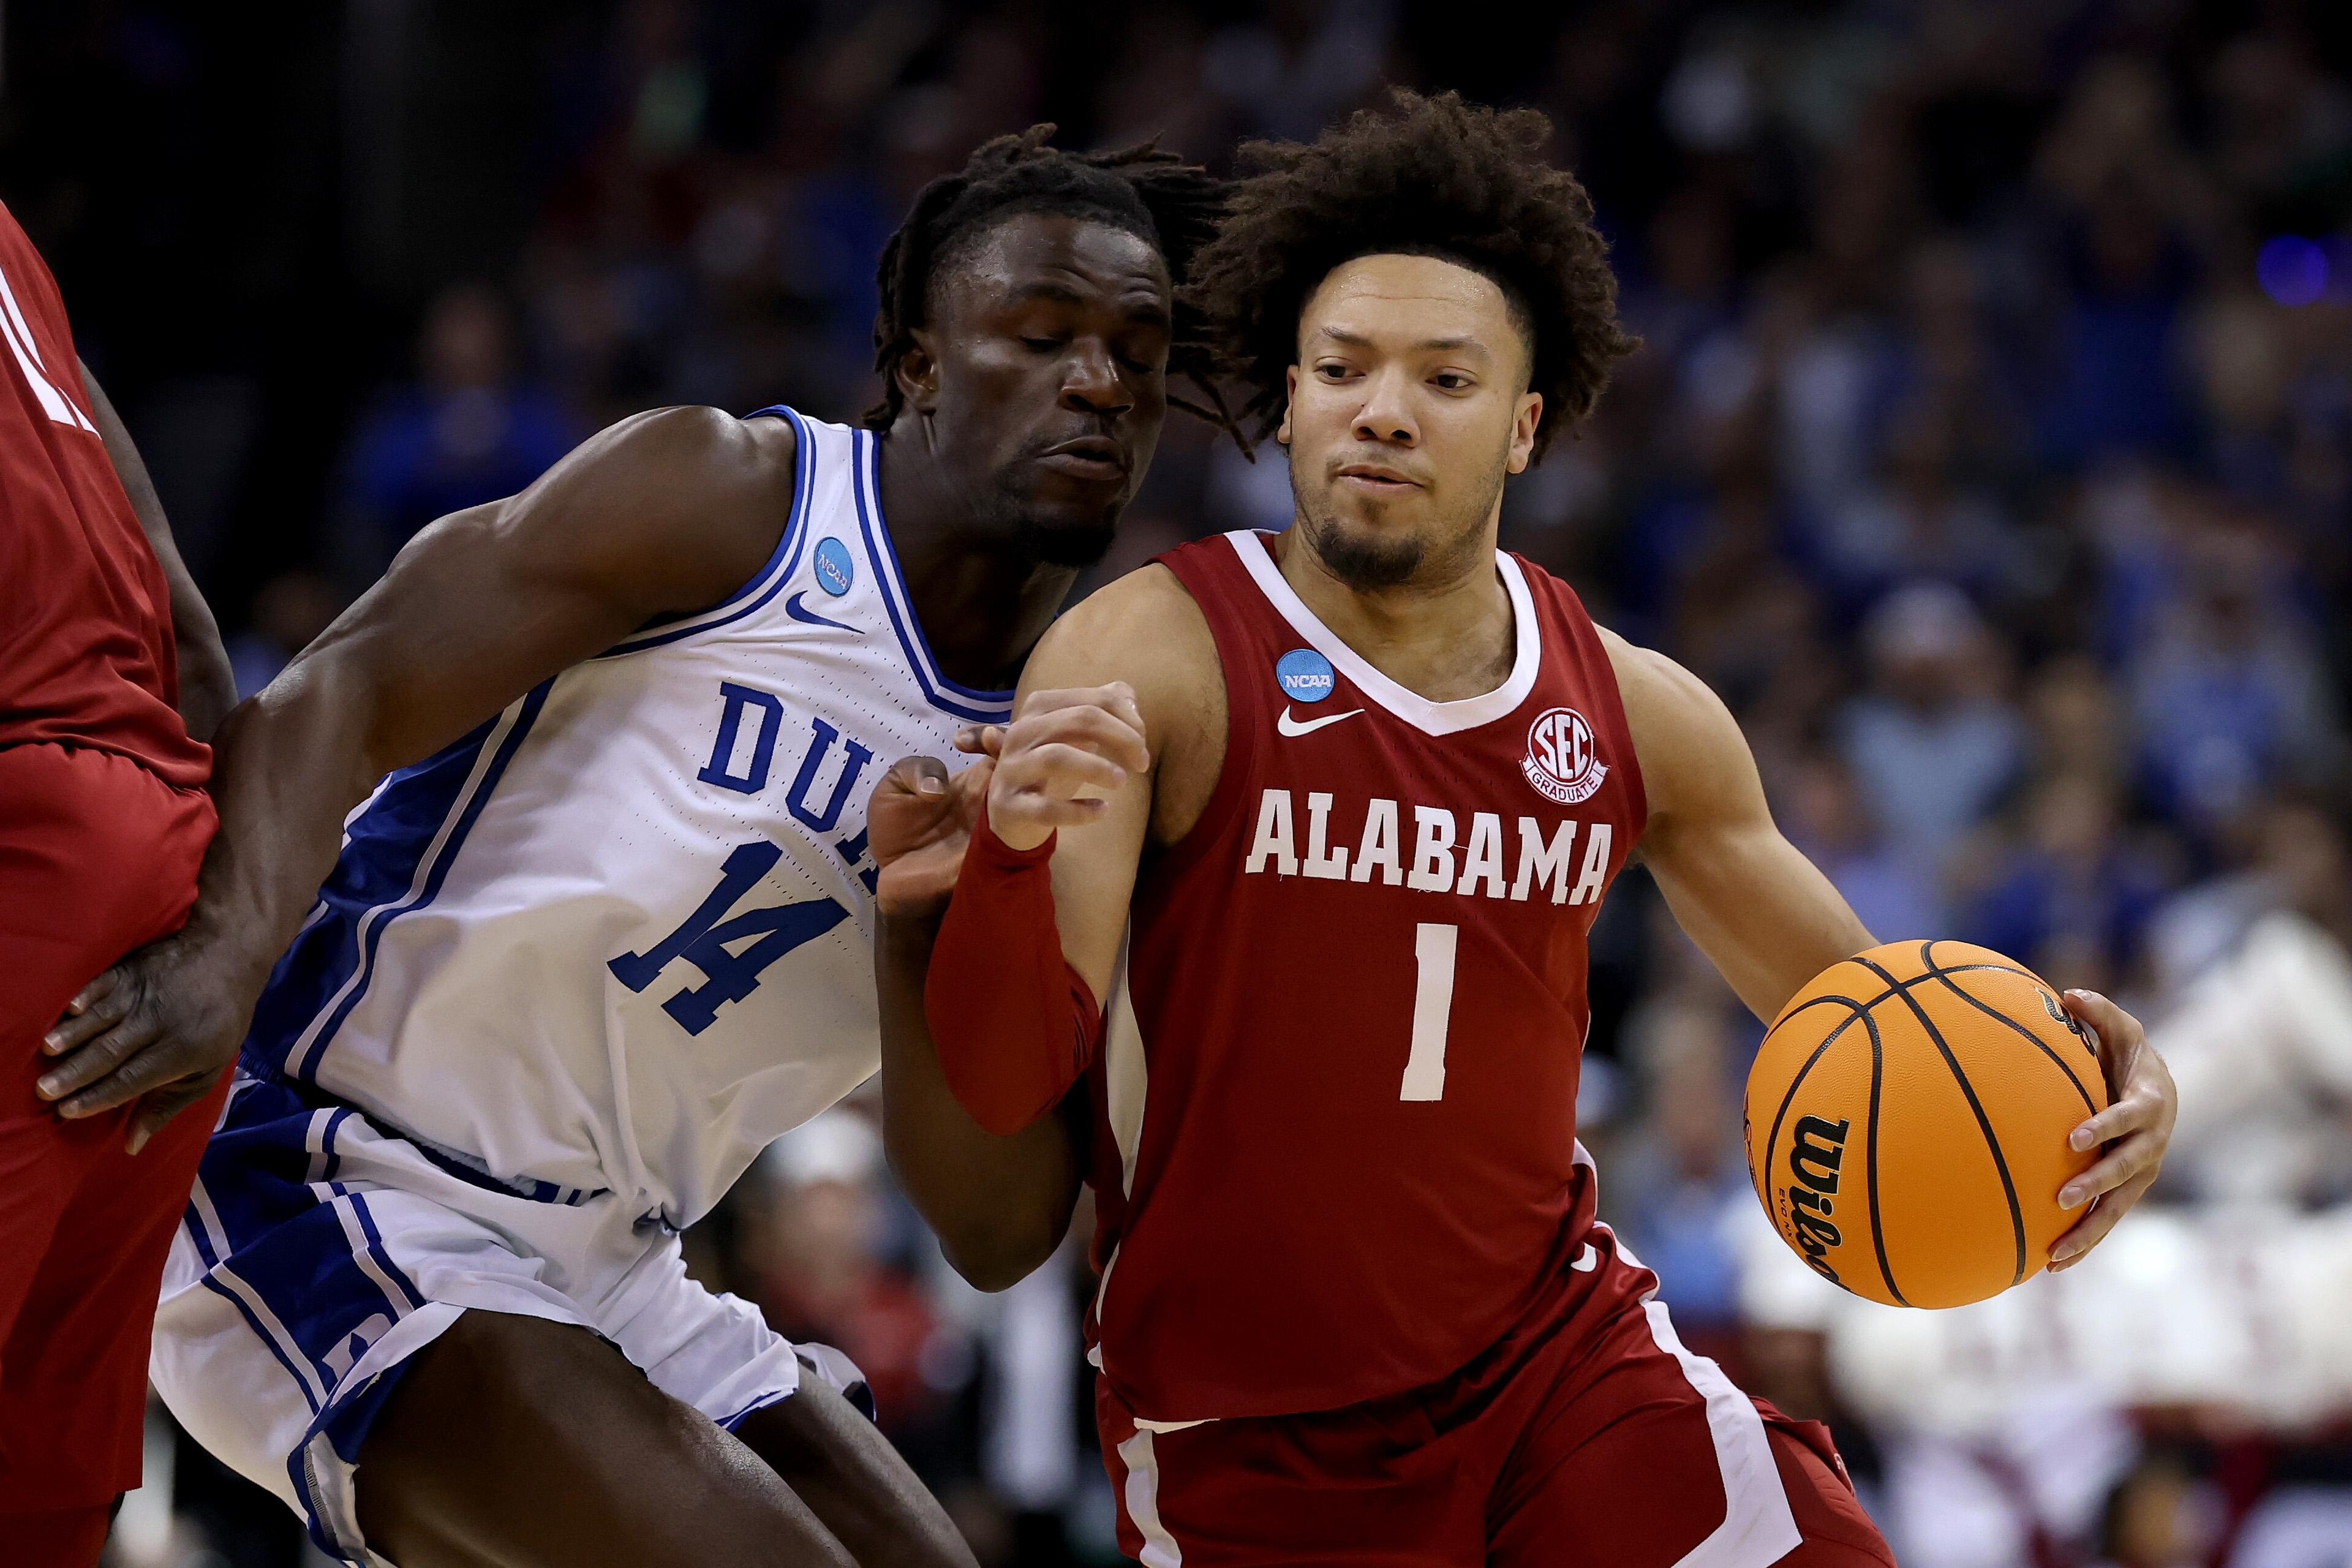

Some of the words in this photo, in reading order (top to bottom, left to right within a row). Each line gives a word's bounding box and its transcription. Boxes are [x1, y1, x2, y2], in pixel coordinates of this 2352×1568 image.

[818, 554, 848, 590] NCAA
[1284, 674, 1332, 688] NCAA
[1534, 714, 1588, 780] SEC
[1532, 772, 1598, 801] GRADUATE
[1245, 788, 1613, 905] ALABAMA
[607, 840, 851, 1037] 14
[1400, 922, 1458, 1102] 1
[1779, 1187, 1788, 1218] EVO
[1789, 1115, 1850, 1289] Wilso
